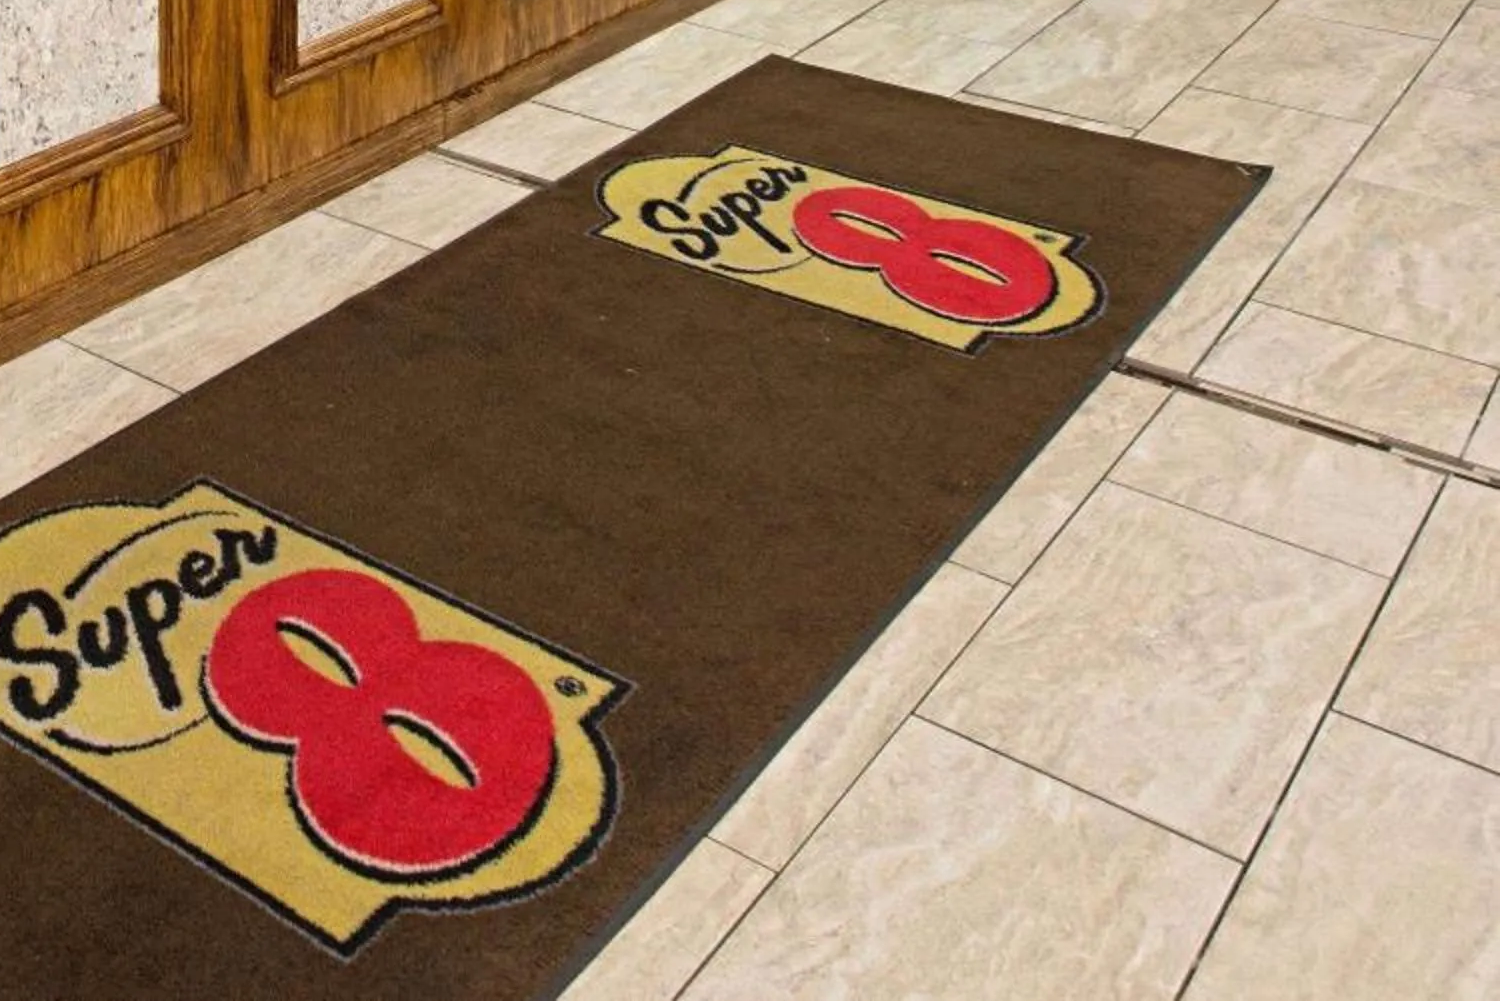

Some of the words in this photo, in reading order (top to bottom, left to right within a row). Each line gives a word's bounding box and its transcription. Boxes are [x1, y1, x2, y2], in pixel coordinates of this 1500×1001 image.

[640, 163, 808, 261] Super
[791, 186, 1060, 327] 8
[200, 567, 561, 886] 8
